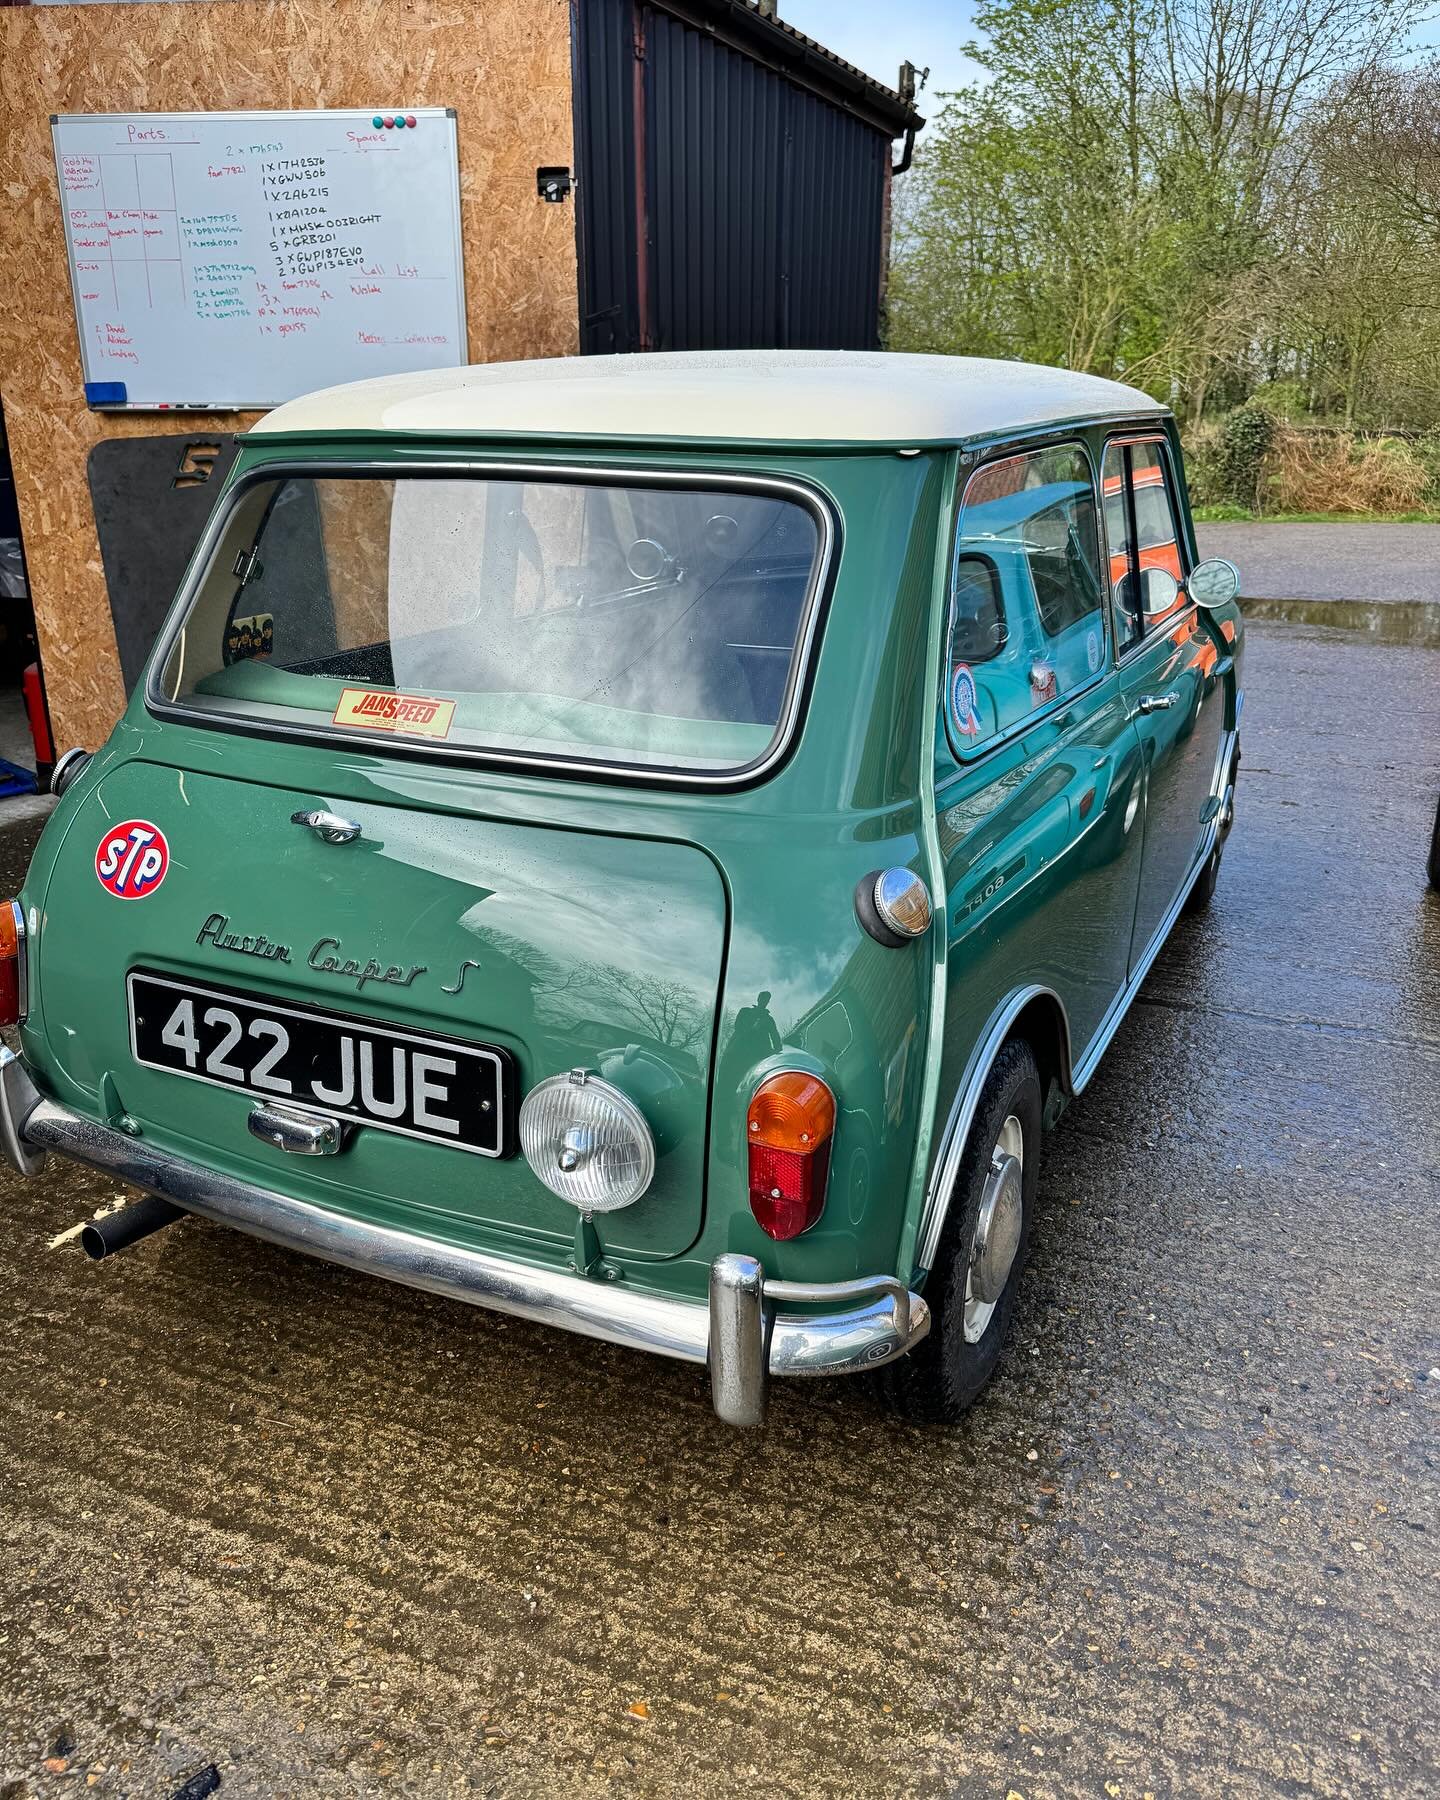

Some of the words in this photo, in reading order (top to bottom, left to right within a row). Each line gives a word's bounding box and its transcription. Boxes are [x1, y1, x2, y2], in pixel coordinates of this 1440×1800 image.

[351, 693, 438, 724] JANSPEED
[99, 826, 163, 893] STP
[196, 913, 292, 963] Austin
[307, 937, 428, 990] Cooper
[440, 959, 480, 995] S
[160, 999, 293, 1095] 422
[310, 1036, 460, 1135] JUE
